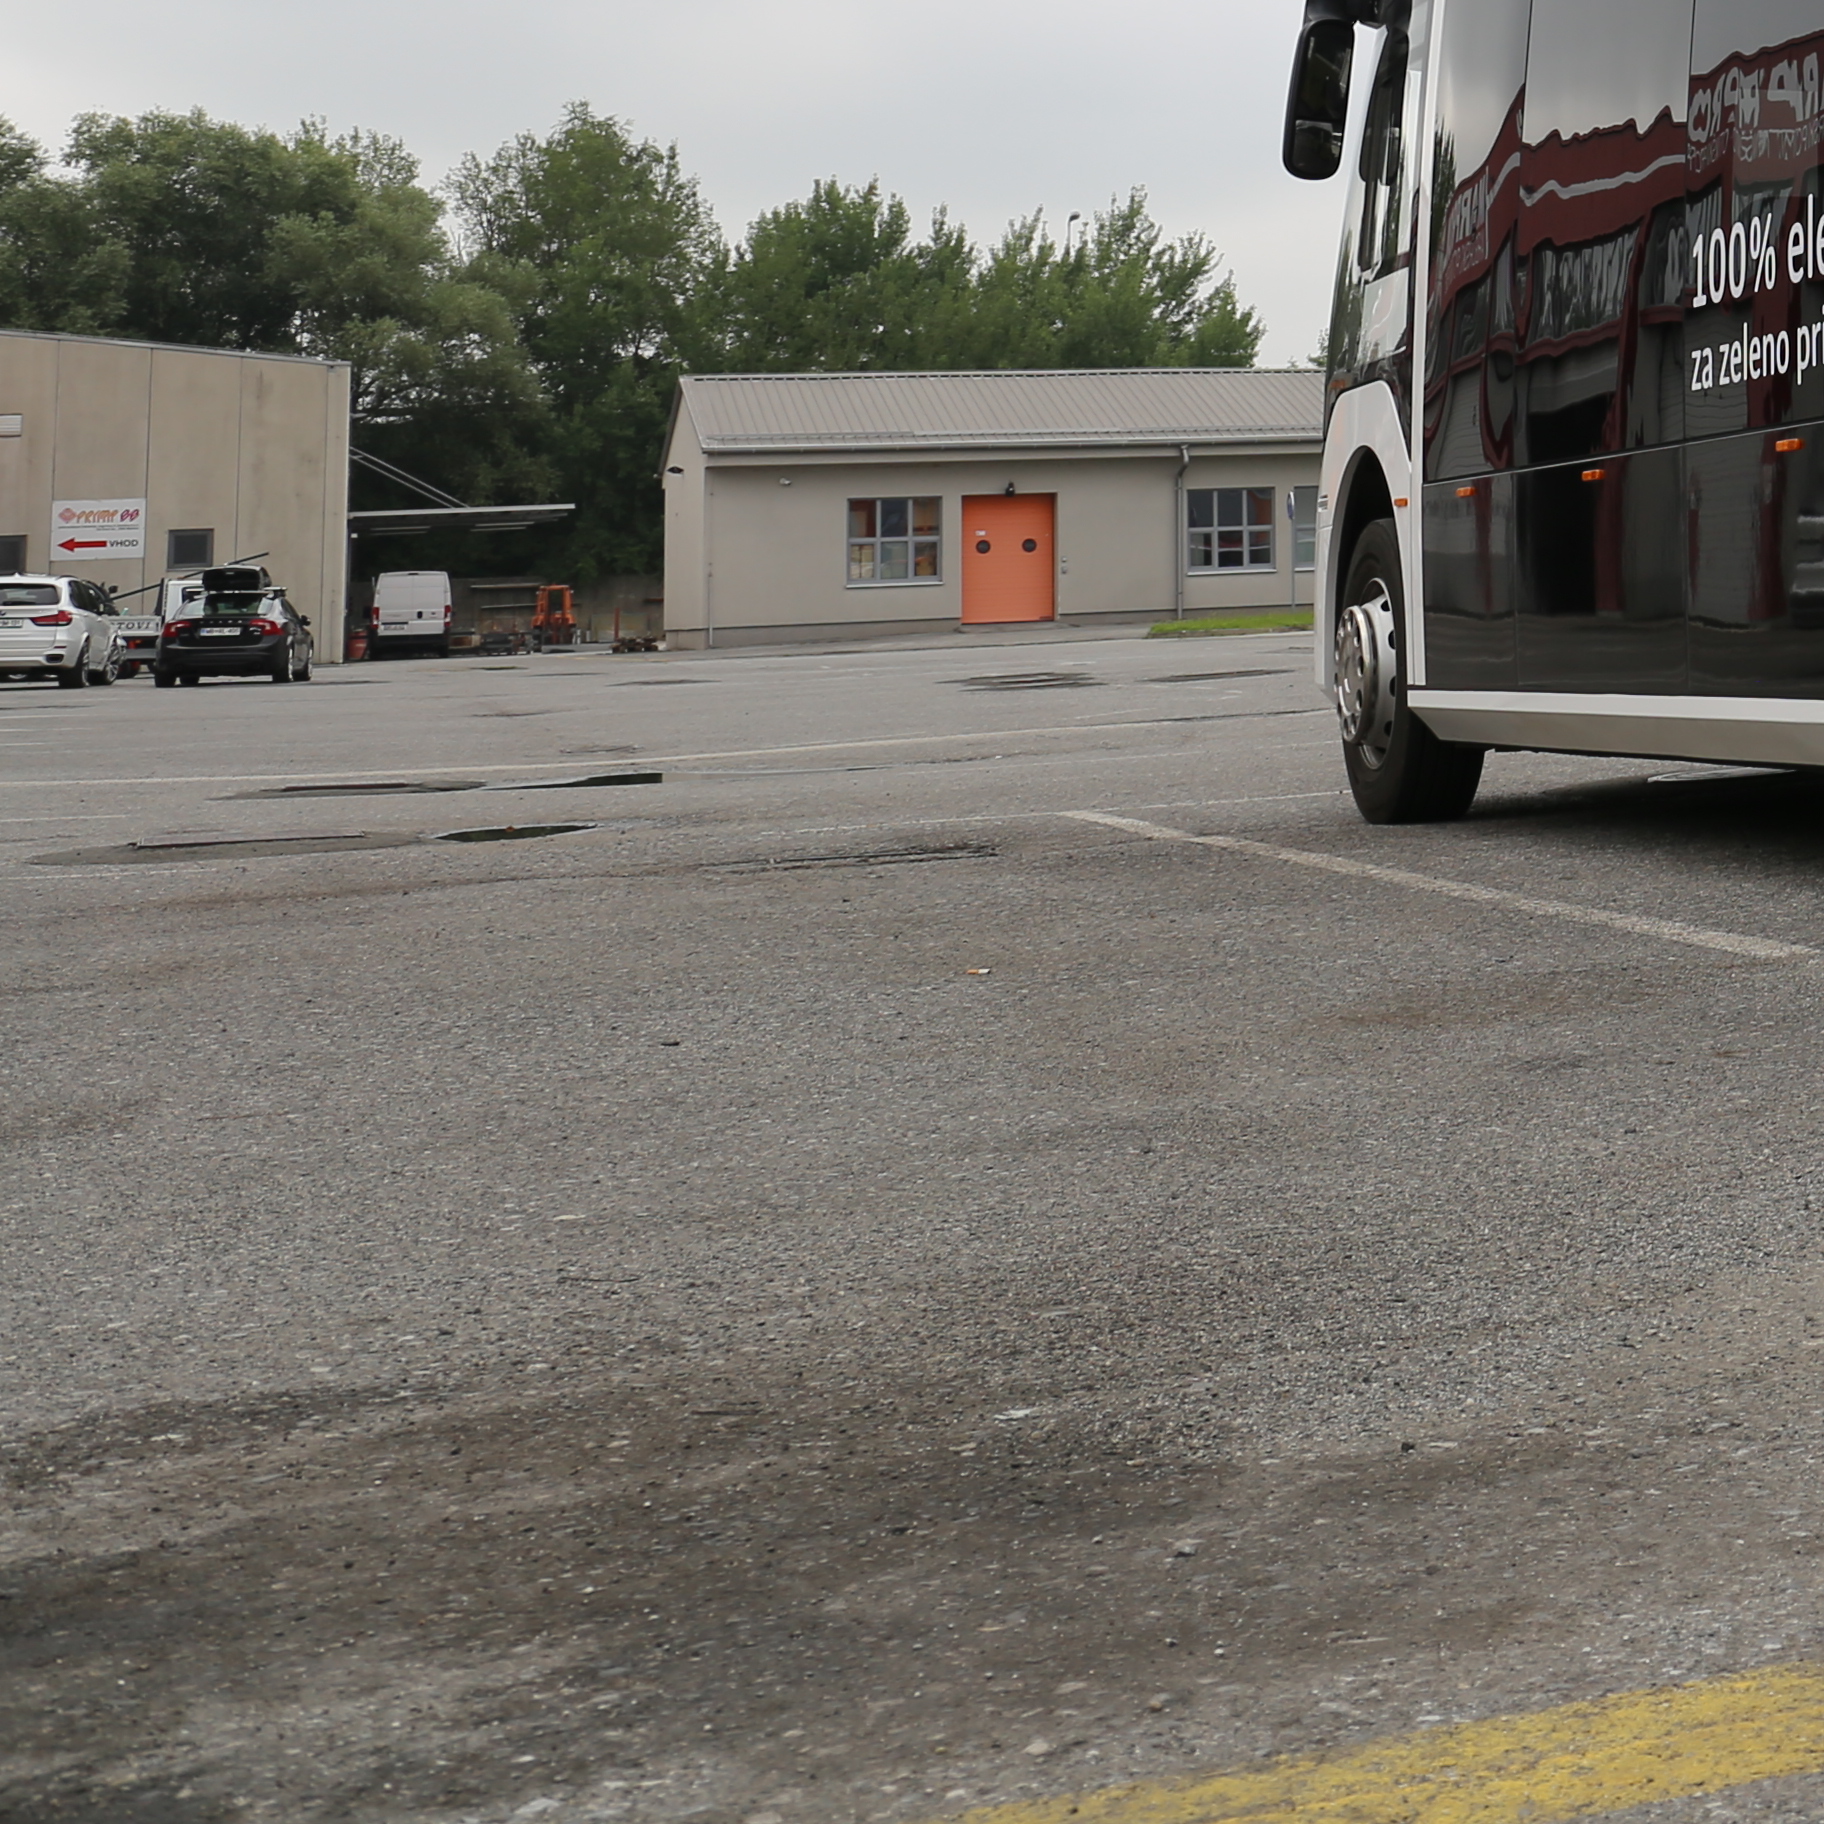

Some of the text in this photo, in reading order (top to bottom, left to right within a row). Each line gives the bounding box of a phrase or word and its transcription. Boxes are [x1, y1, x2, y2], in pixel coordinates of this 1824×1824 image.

[1692, 212, 1777, 308] 100%
[1690, 347, 1713, 391] za
[1718, 322, 1790, 386] zeleno
[109, 539, 139, 547] VHOD
